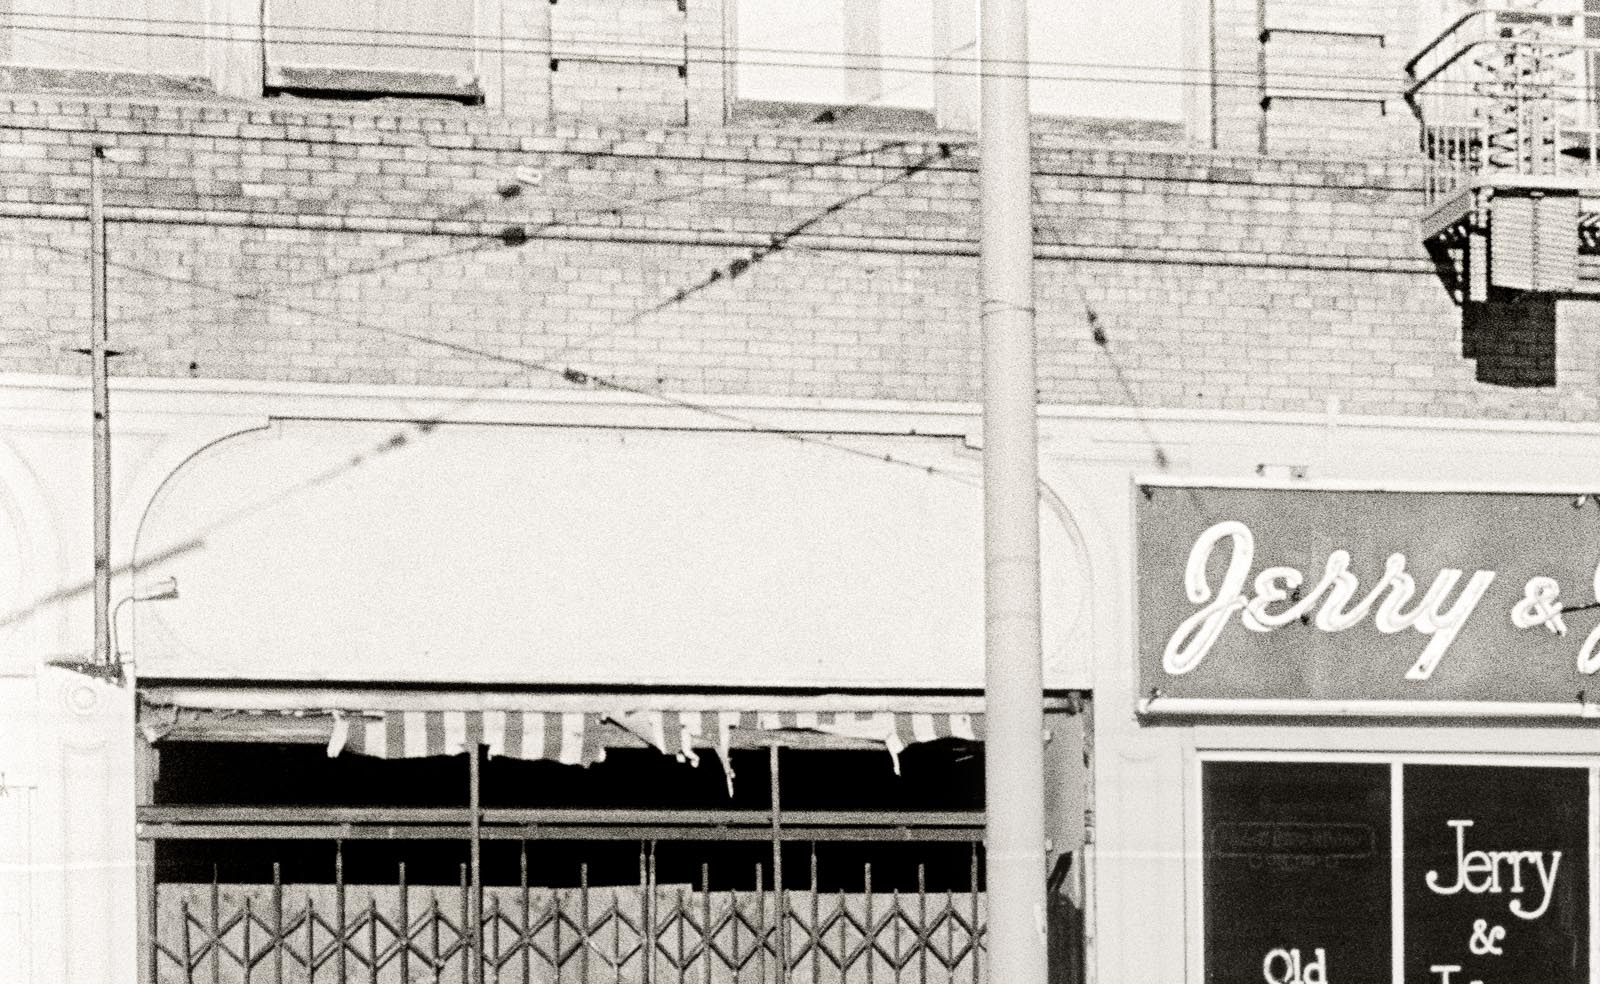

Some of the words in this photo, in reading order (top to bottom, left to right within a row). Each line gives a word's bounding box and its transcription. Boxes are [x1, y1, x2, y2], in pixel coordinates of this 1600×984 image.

[1162, 520, 1497, 681] Jerry
[1511, 575, 1568, 637] &
[1425, 819, 1562, 919] Jerry
[1468, 918, 1506, 956] &
